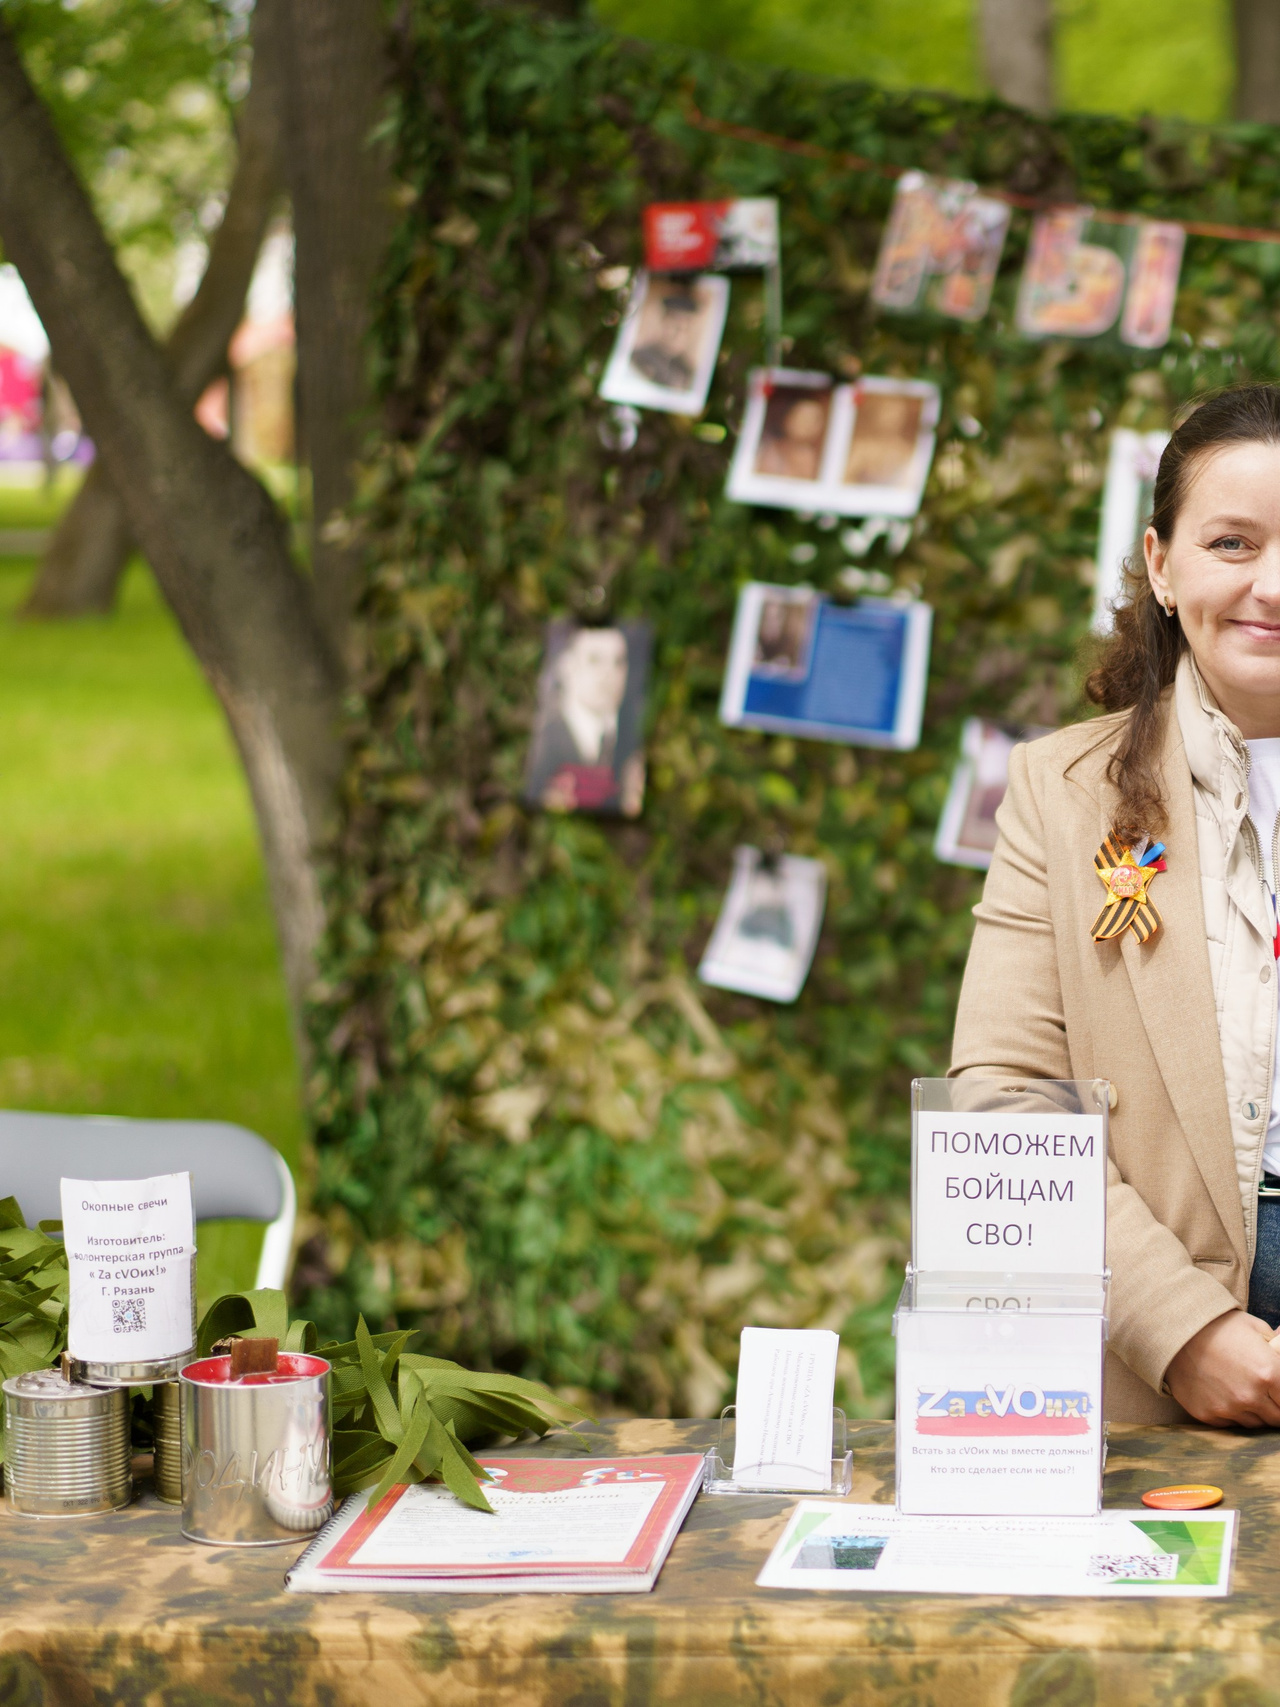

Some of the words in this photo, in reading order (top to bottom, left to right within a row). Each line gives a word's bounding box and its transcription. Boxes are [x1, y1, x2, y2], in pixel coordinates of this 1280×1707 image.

[870, 170, 1186, 350] МЫ
[932, 1131, 1094, 1157] ПОМОЖЕМ
[946, 1172, 1073, 1206] БОЙЦАМ
[81, 1200, 134, 1212] Окопные
[138, 1198, 168, 1211] свечи
[87, 1233, 166, 1247] Изготовитель:
[966, 1223, 1032, 1246] СВО!
[74, 1251, 145, 1264] волонтерская
[148, 1246, 184, 1260] группа
[101, 1286, 110, 1296] Г.
[114, 1286, 155, 1296] Рязань
[912, 1447, 943, 1455] Встать
[1011, 1448, 1046, 1456] вместе
[1048, 1447, 1094, 1457] должны!
[930, 1466, 947, 1474] Кто
[968, 1467, 1007, 1475] сделает
[1010, 1467, 1032, 1475] если
[1035, 1467, 1047, 1475] не
[1050, 1466, 1075, 1475] мы?!
